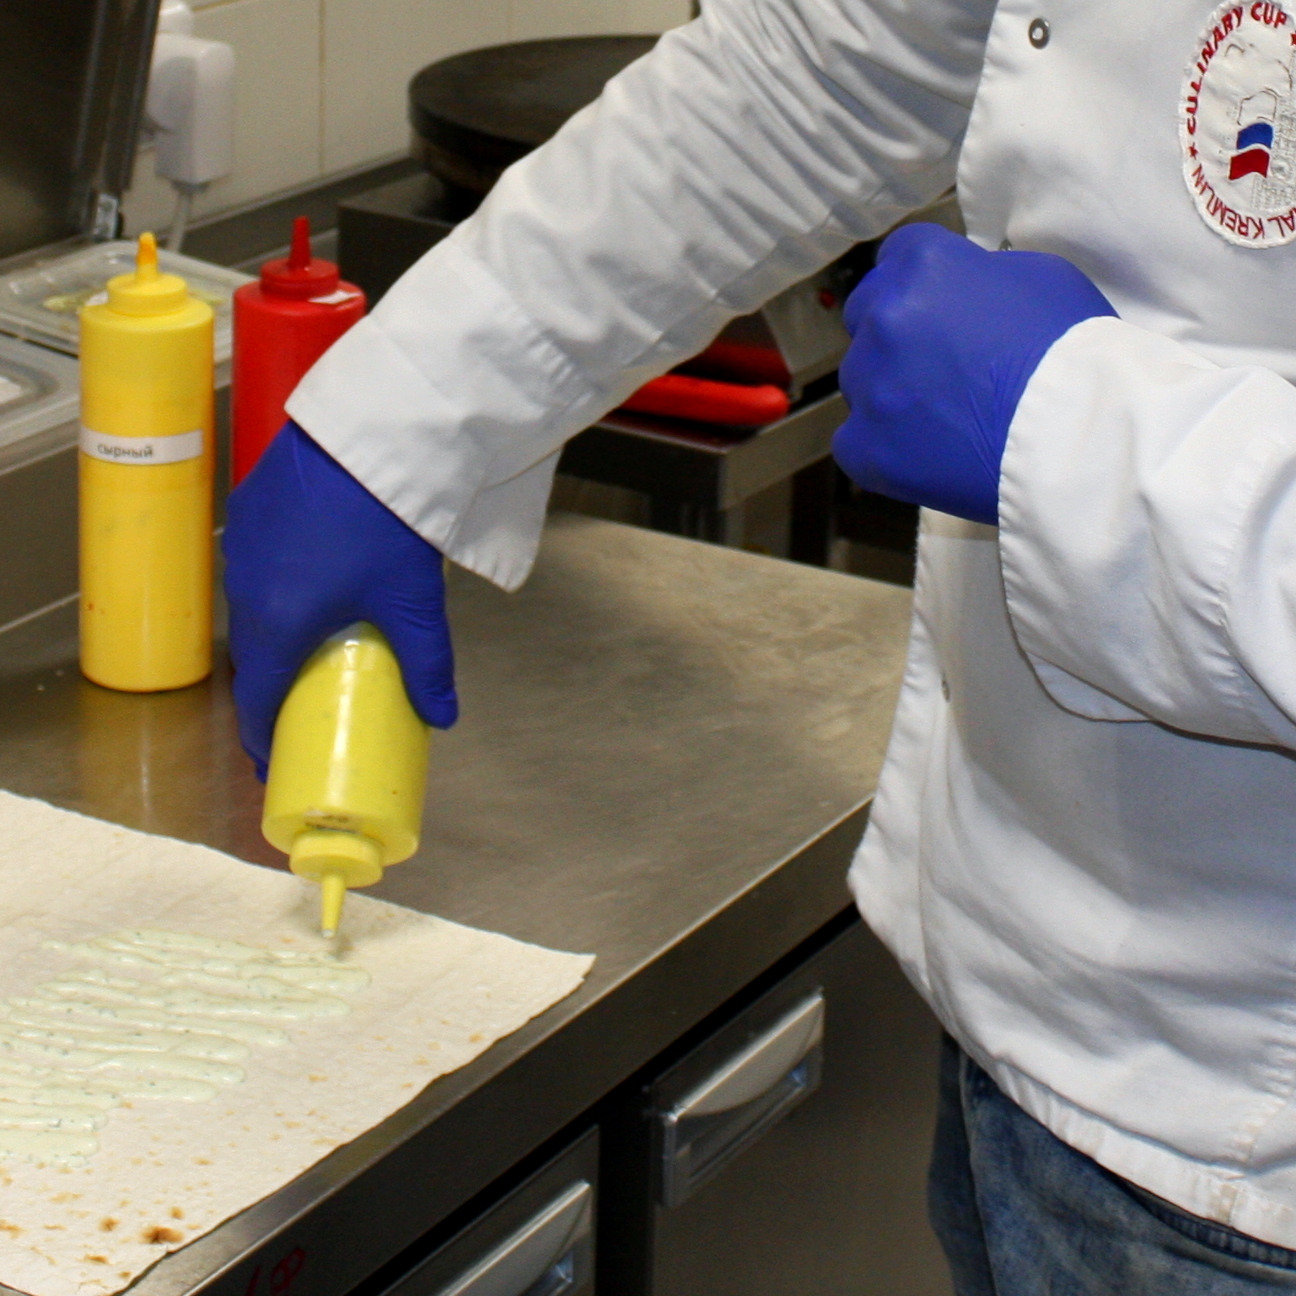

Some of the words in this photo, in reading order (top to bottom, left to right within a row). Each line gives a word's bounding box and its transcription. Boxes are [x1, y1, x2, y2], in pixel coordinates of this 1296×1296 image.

[1186, 6, 1243, 135] CULINARY
[1250, 2, 1287, 28] CUP
[1190, 163, 1266, 240] KREMLIN
